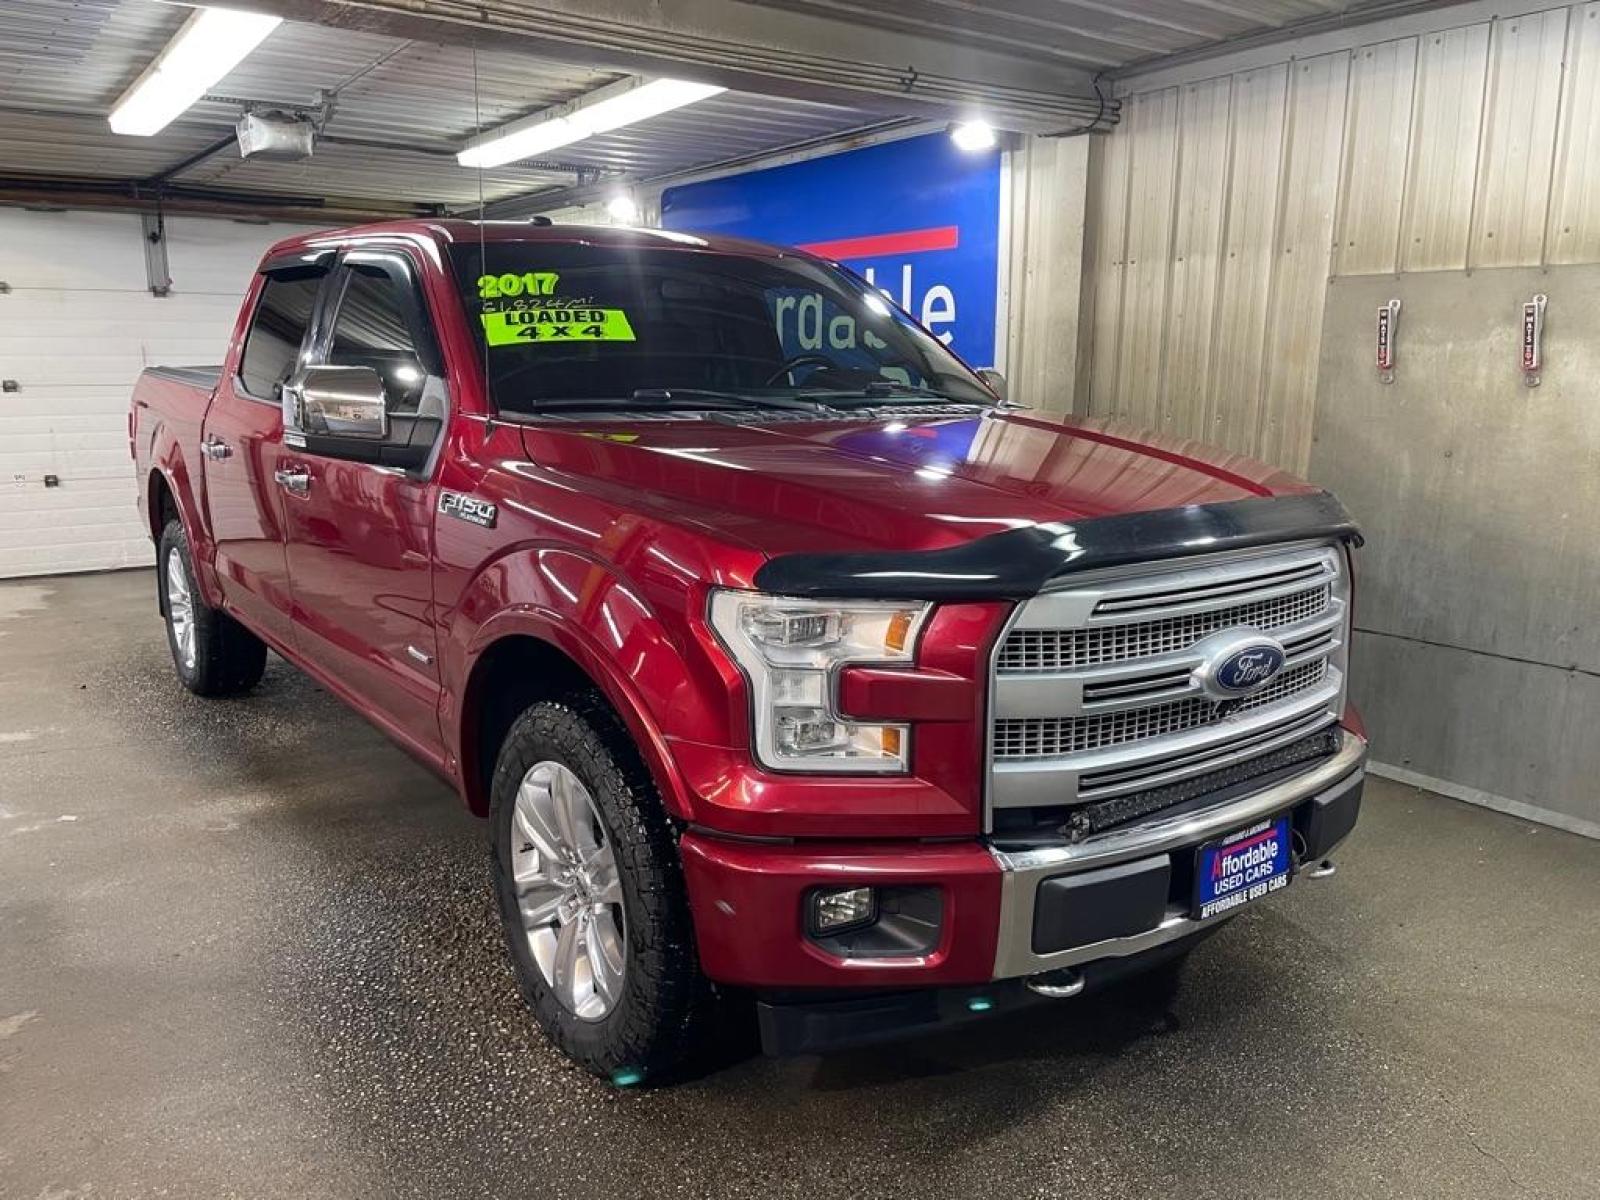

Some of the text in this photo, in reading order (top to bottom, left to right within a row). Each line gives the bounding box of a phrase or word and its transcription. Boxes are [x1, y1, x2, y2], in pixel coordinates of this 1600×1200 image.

[478, 272, 559, 298] 2017
[505, 310, 606, 326] LOADED
[1233, 653, 1273, 685] Ford
[1211, 840, 1278, 880] Affordable
[1214, 861, 1273, 895] USED CARS
[1202, 874, 1287, 919] AFFORDABLE USED CARS
